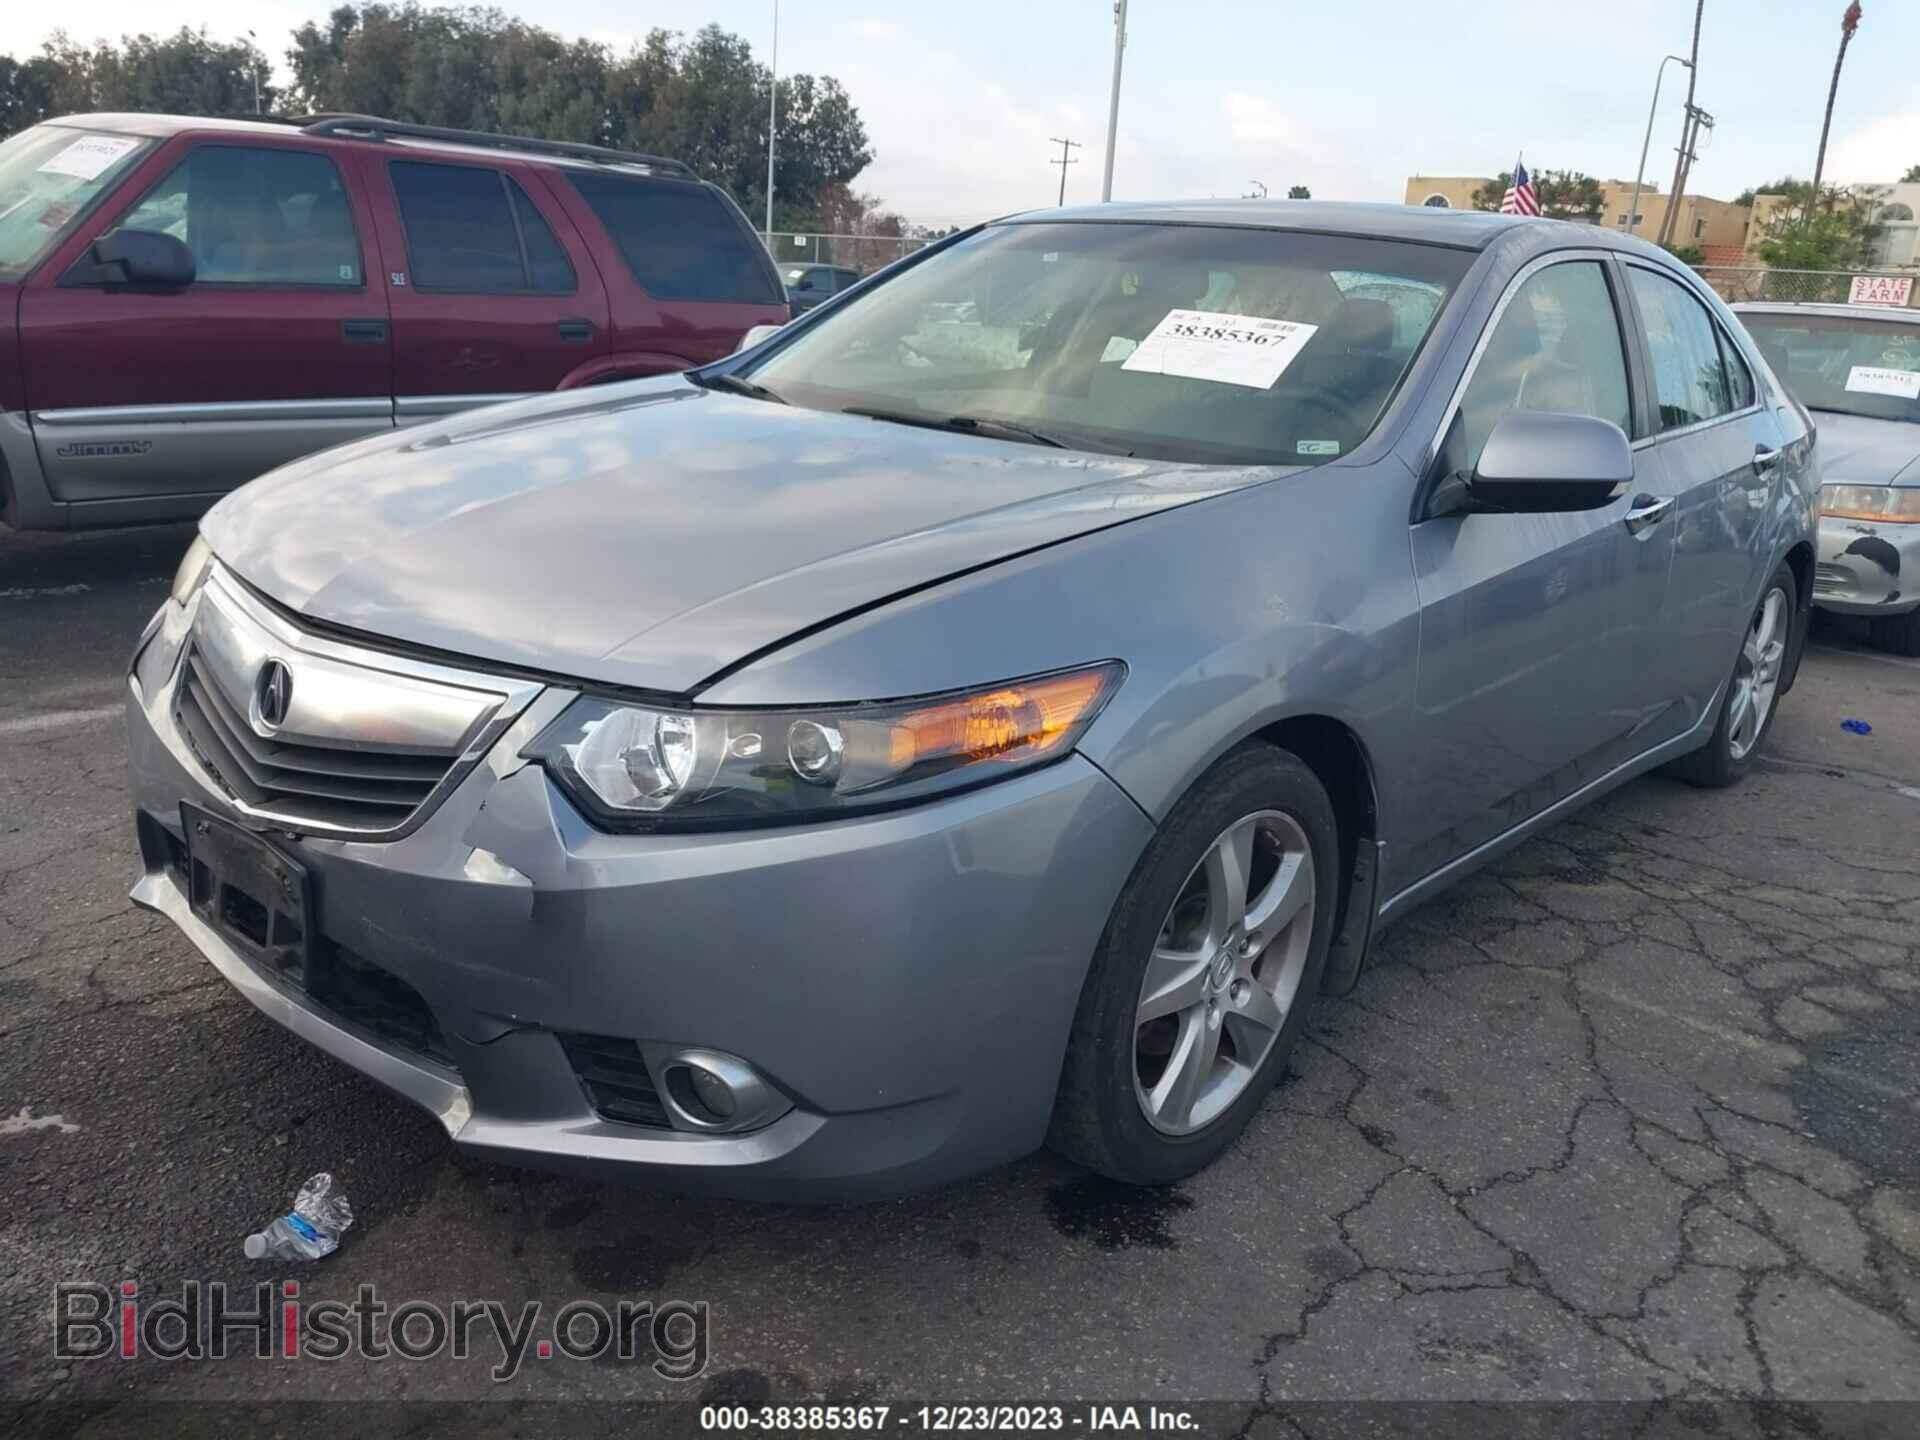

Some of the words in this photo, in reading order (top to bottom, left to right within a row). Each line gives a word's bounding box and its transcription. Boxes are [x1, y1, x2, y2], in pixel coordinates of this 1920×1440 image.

[1855, 278, 1910, 289] STATE
[1855, 289, 1905, 300] FARM
[1164, 323, 1287, 346] 38385367
